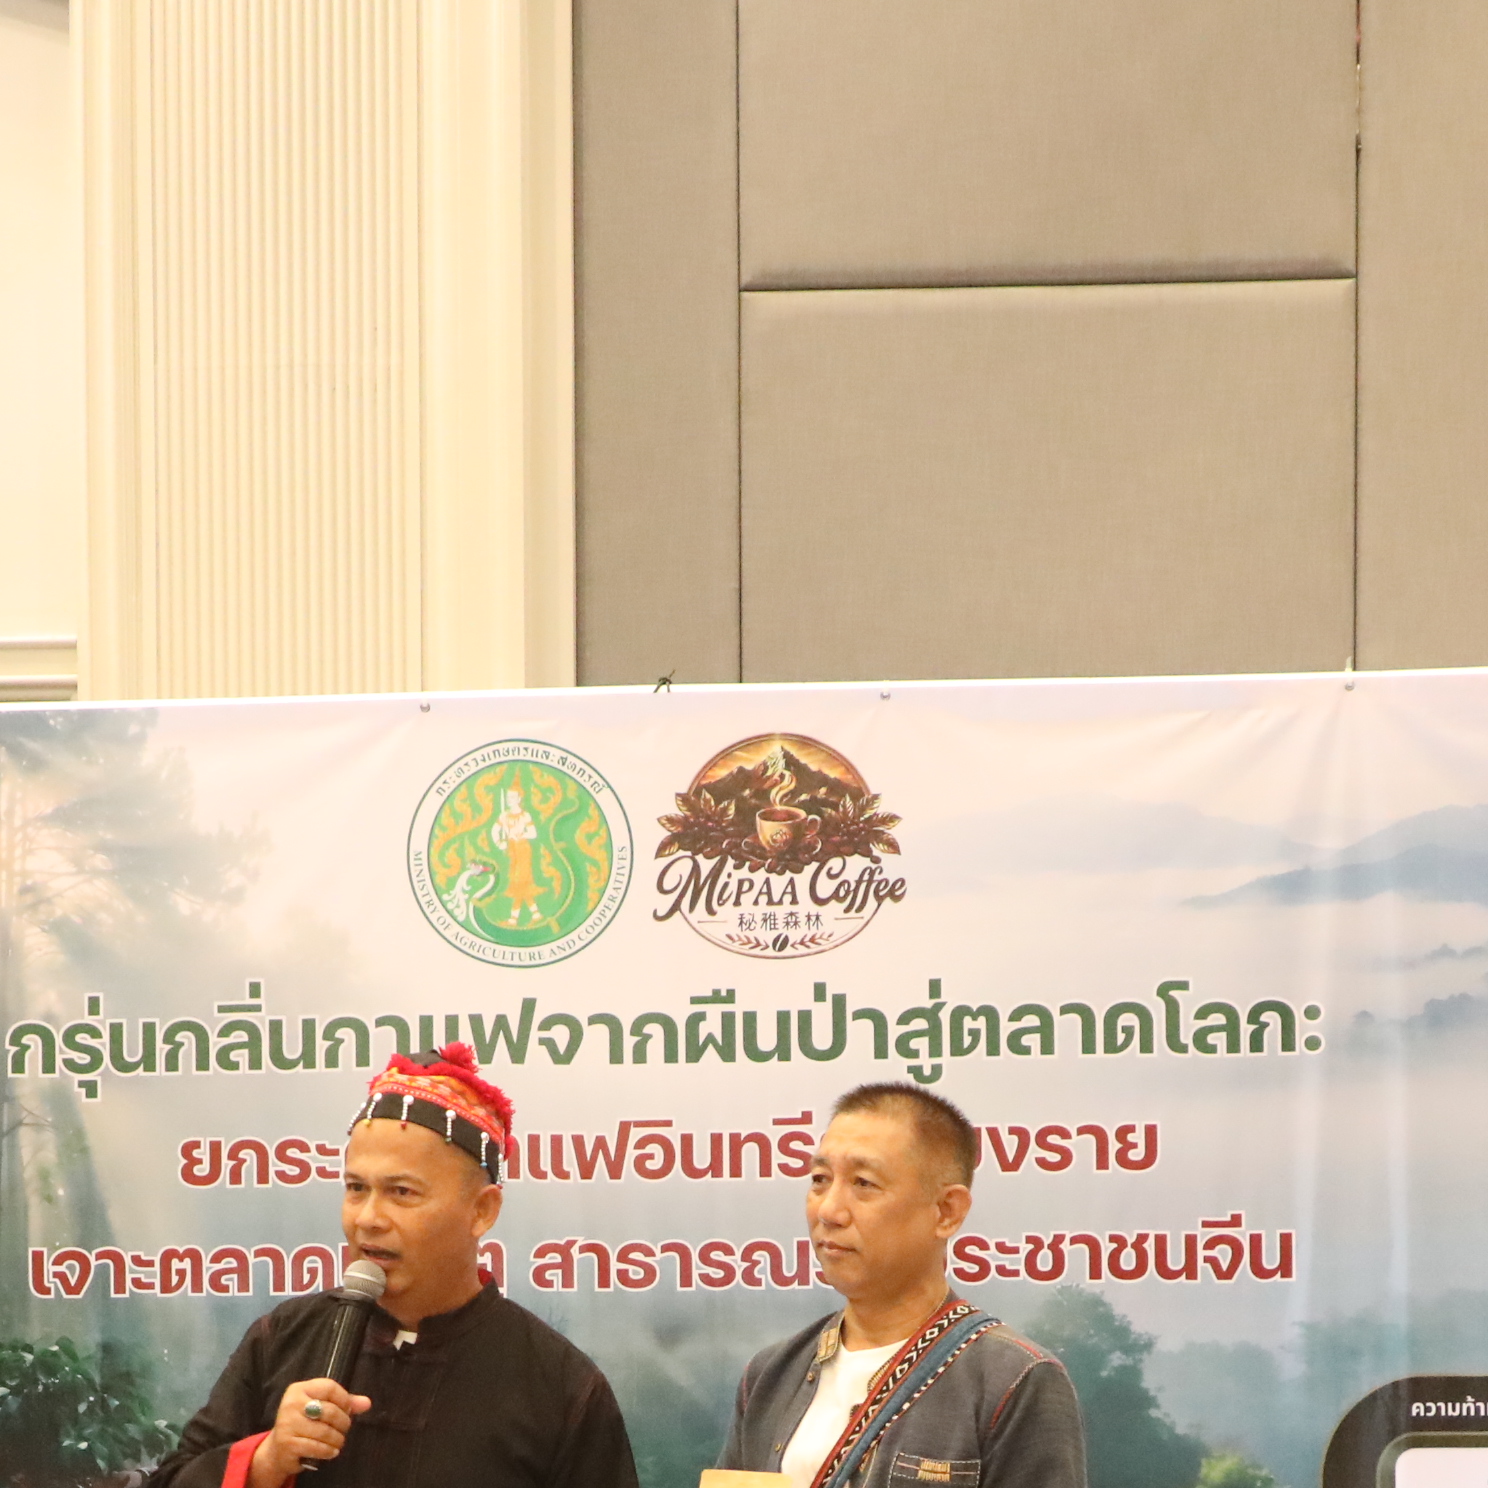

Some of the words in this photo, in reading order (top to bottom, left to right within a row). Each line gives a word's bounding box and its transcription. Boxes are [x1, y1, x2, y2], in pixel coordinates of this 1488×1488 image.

[413, 849, 442, 916] MINISTRY
[436, 914, 453, 932] OF
[452, 931, 546, 963] AGRICULTURE
[548, 938, 577, 959] AND
[576, 845, 628, 942] COOPERATIVES
[809, 856, 908, 915] Coffee
[737, 910, 824, 932] 秘雅森林
